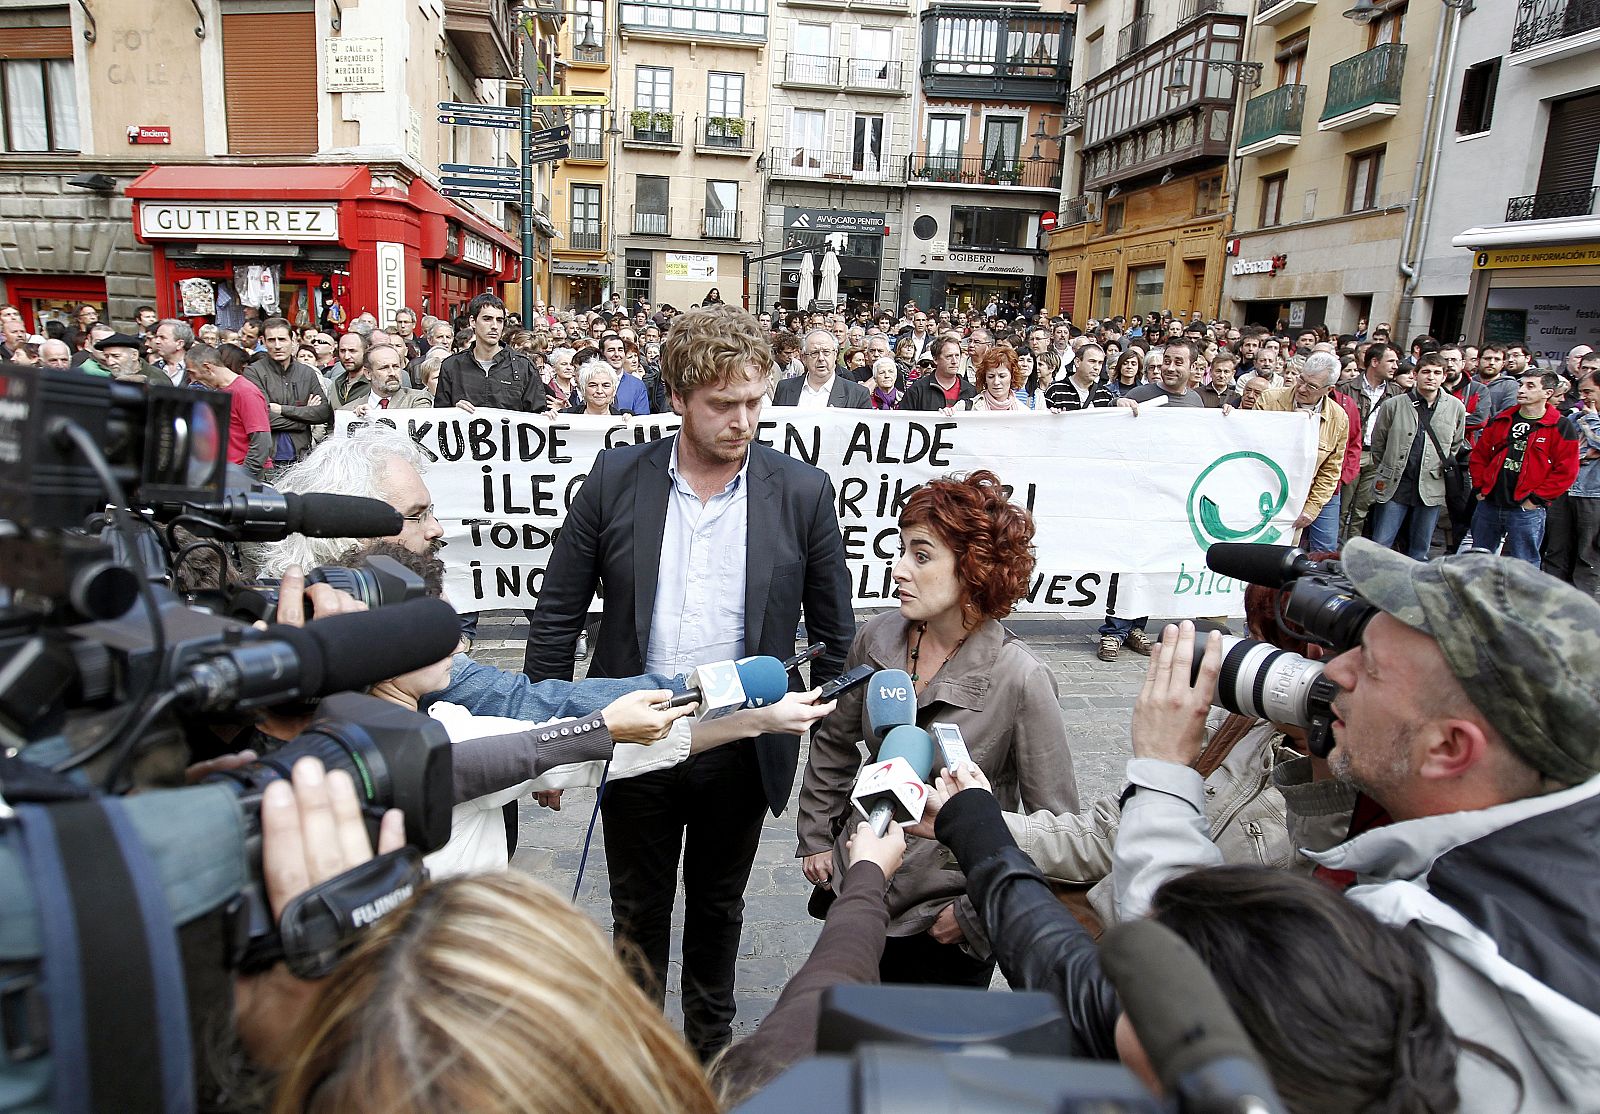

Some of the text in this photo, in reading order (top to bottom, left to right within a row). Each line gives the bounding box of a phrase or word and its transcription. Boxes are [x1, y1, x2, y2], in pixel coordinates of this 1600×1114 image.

[158, 209, 321, 231] GUTIERREZ
[816, 215, 857, 225] AVVOCATO
[920, 254, 927, 265] 2
[949, 253, 996, 264] OGIBERRI
[1495, 255, 1520, 263] PUNTO
[1520, 254, 1530, 262] DE
[1531, 250, 1585, 261] INFORMACIÓN
[987, 265, 1024, 273] momentico
[1540, 326, 1577, 335] cultural
[842, 421, 958, 467] ALDE
[880, 685, 907, 701] tve
